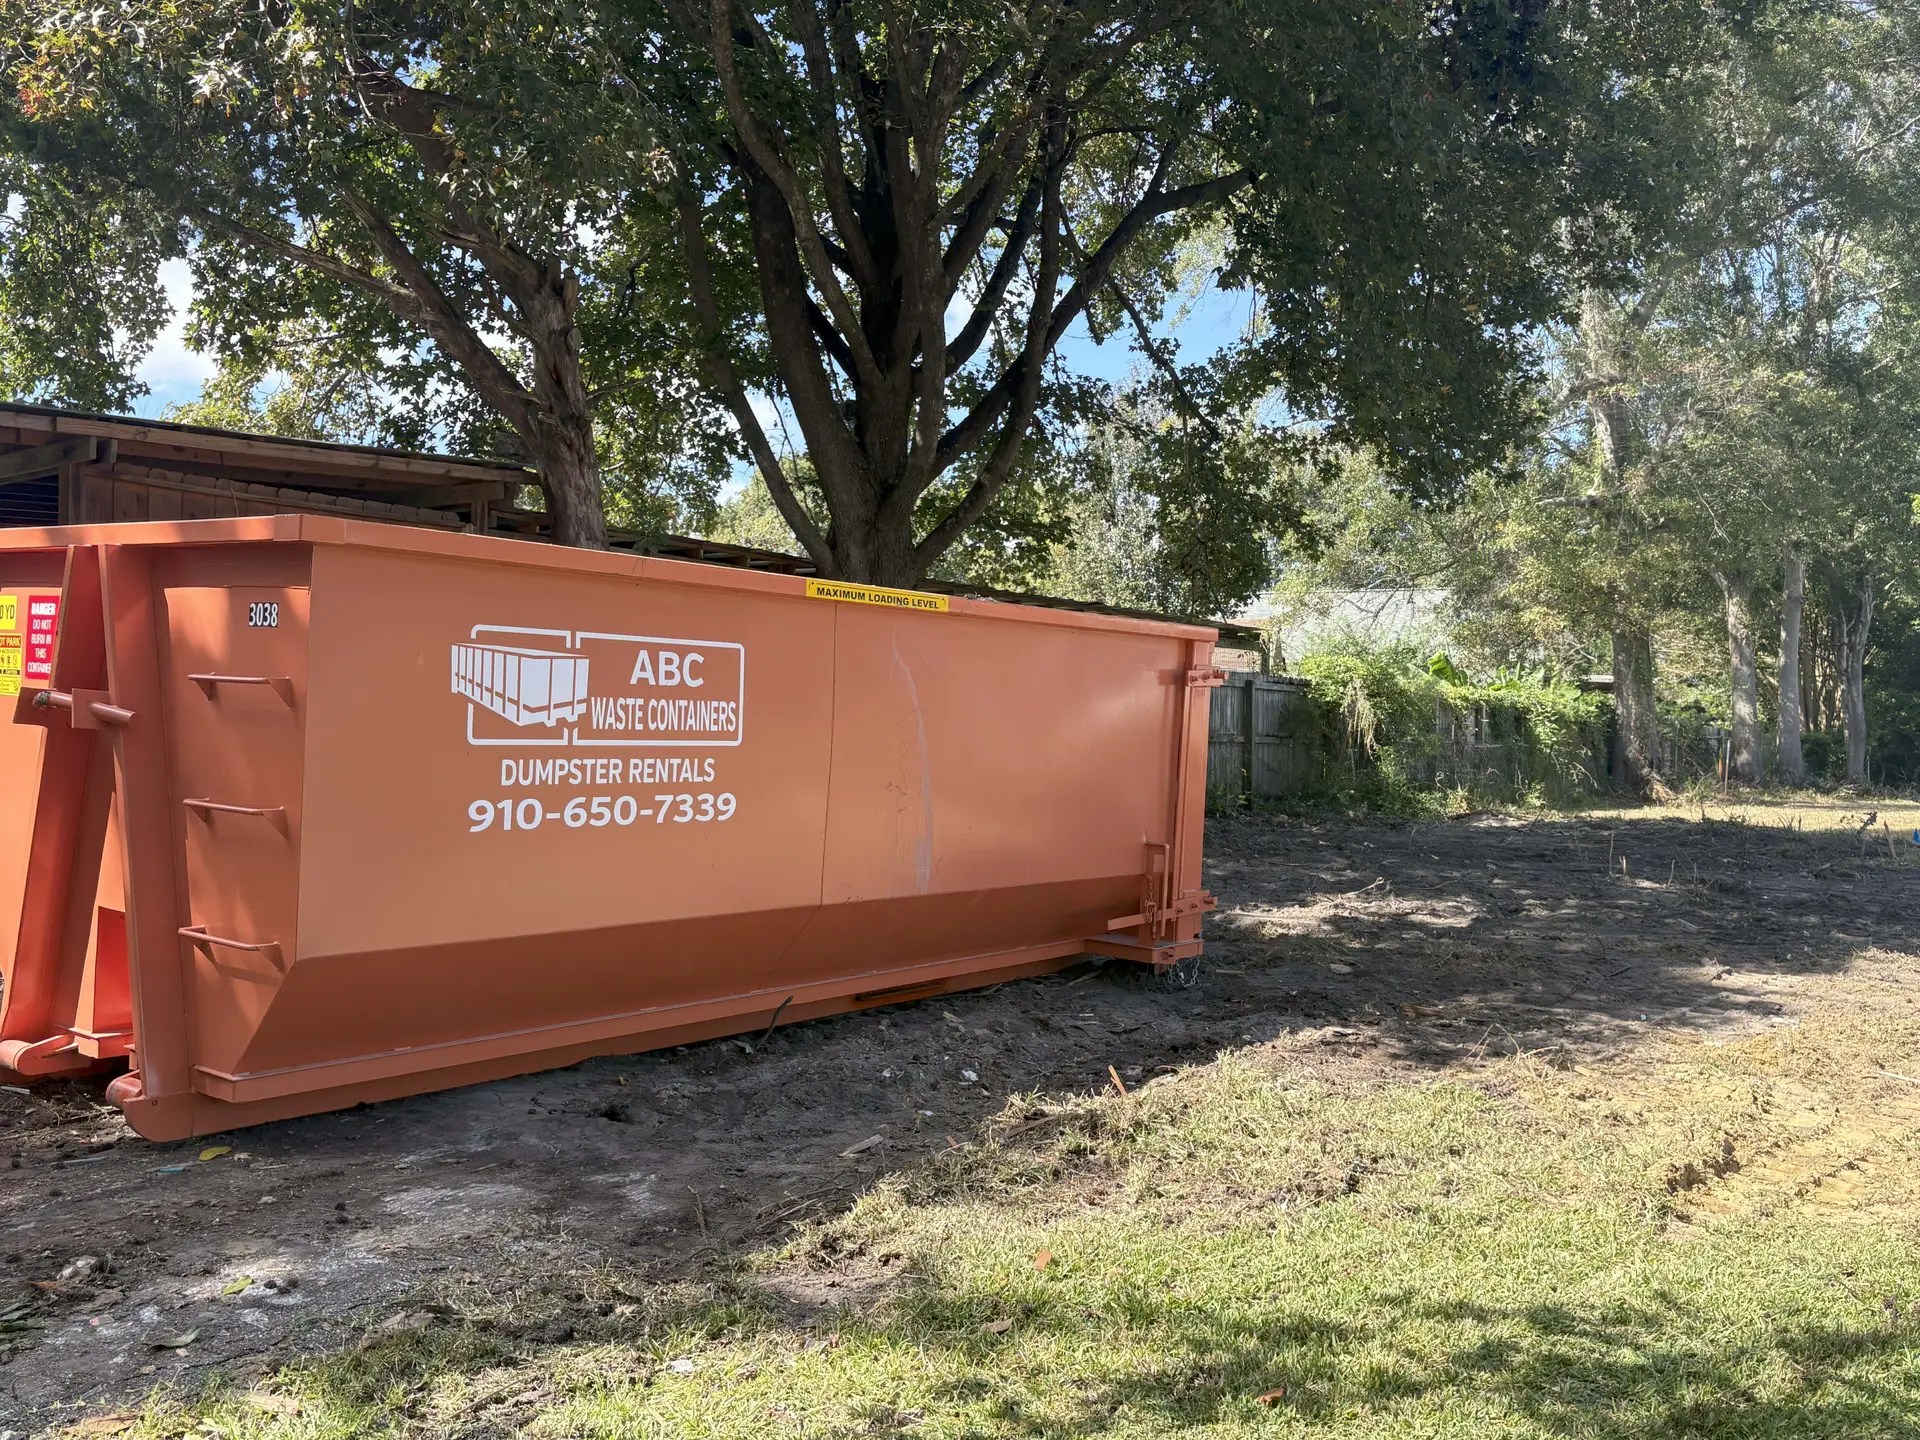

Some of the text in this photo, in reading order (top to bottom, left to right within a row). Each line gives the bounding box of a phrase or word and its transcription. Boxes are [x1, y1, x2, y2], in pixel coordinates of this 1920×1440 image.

[31, 603, 56, 615] DANGER
[816, 587, 939, 610] MAXIMUM LOADING LEVEL
[6, 604, 15, 619] YD
[249, 602, 278, 627] 3038
[33, 619, 52, 630] DO NOT
[31, 634, 52, 644] BURN IN
[35, 648, 46, 659] THIS
[630, 649, 705, 688] ABC
[591, 697, 737, 733] WASTE CONTAINERS
[501, 757, 715, 786] DUMPSTER RENTALS
[467, 792, 737, 833] 910-650-7339
